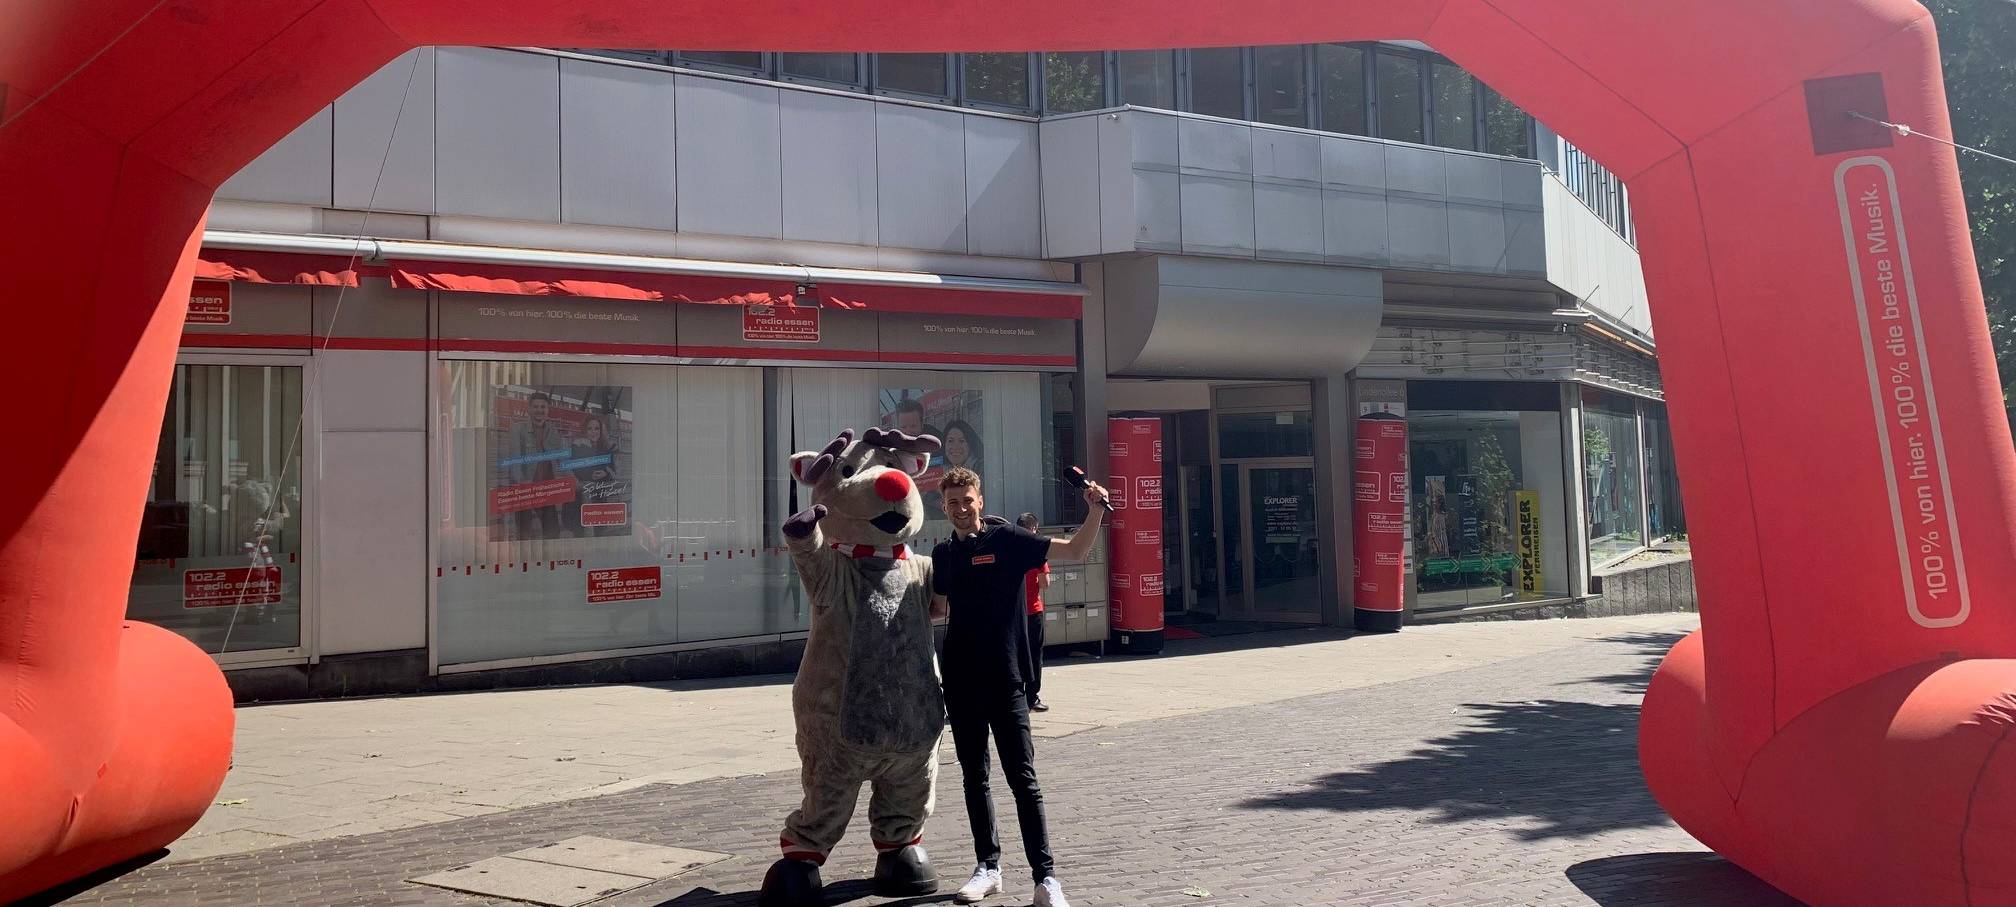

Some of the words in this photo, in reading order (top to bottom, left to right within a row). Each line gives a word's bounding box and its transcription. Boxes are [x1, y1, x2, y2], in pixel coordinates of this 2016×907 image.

[1860, 183, 1888, 254] Musik.
[189, 296, 223, 304] ssen
[1877, 259, 1900, 320] beste
[479, 307, 506, 317] 100%
[508, 310, 524, 318] von
[526, 309, 545, 319] hier.
[547, 310, 573, 320] 100%
[574, 311, 587, 320] die
[588, 312, 612, 321] beste
[614, 313, 641, 322] Musik.
[756, 317, 783, 325] radio
[1885, 325, 1906, 356] die
[1890, 362, 1919, 429] 100%
[1906, 433, 1928, 480] hier.
[1264, 497, 1298, 505] EXPLORER
[1917, 485, 1936, 524] von
[1520, 499, 1534, 592] EXPLORER
[190, 572, 226, 582] 102.2
[591, 571, 619, 581] 102.2
[1920, 531, 1948, 600] 100%
[196, 582, 233, 591] radio
[596, 580, 624, 589] radio
[626, 578, 657, 586] essen
